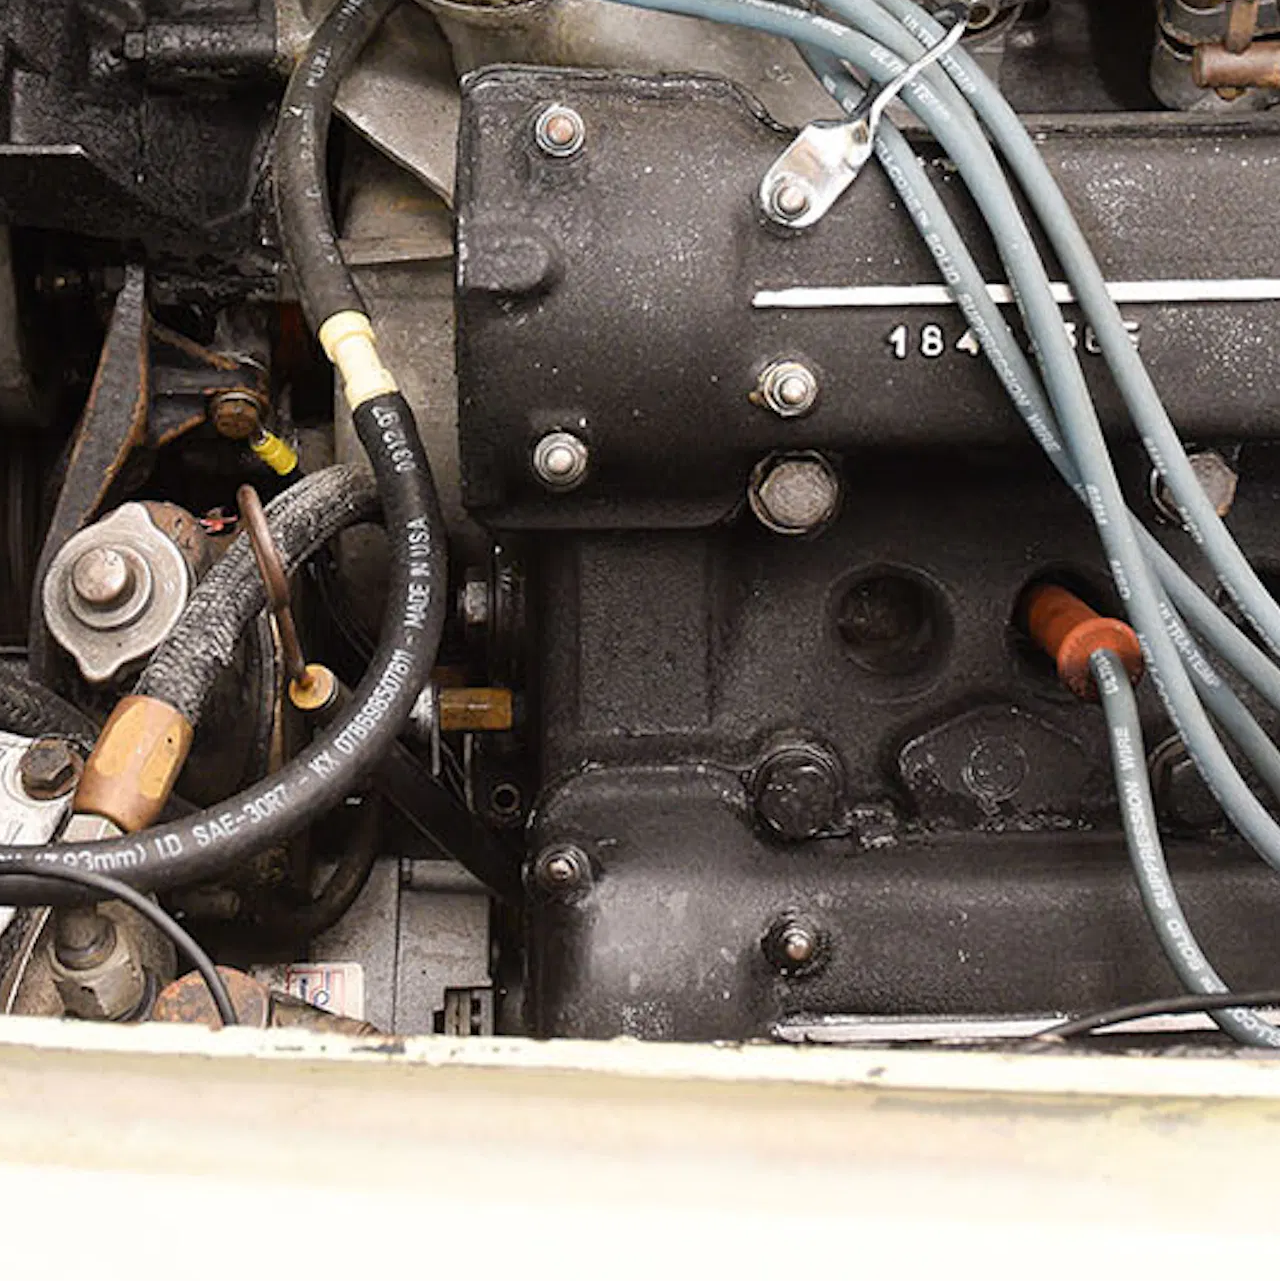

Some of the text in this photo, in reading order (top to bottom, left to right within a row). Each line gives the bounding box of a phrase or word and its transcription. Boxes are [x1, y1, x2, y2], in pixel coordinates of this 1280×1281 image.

[406, 513, 431, 558] USA
[403, 581, 431, 630] MADE
[308, 749, 341, 779] KX
[1113, 726, 1133, 772] WIRE
[1124, 780, 1174, 914] SUPPRESSION
[1165, 919, 1205, 974] SOLID
